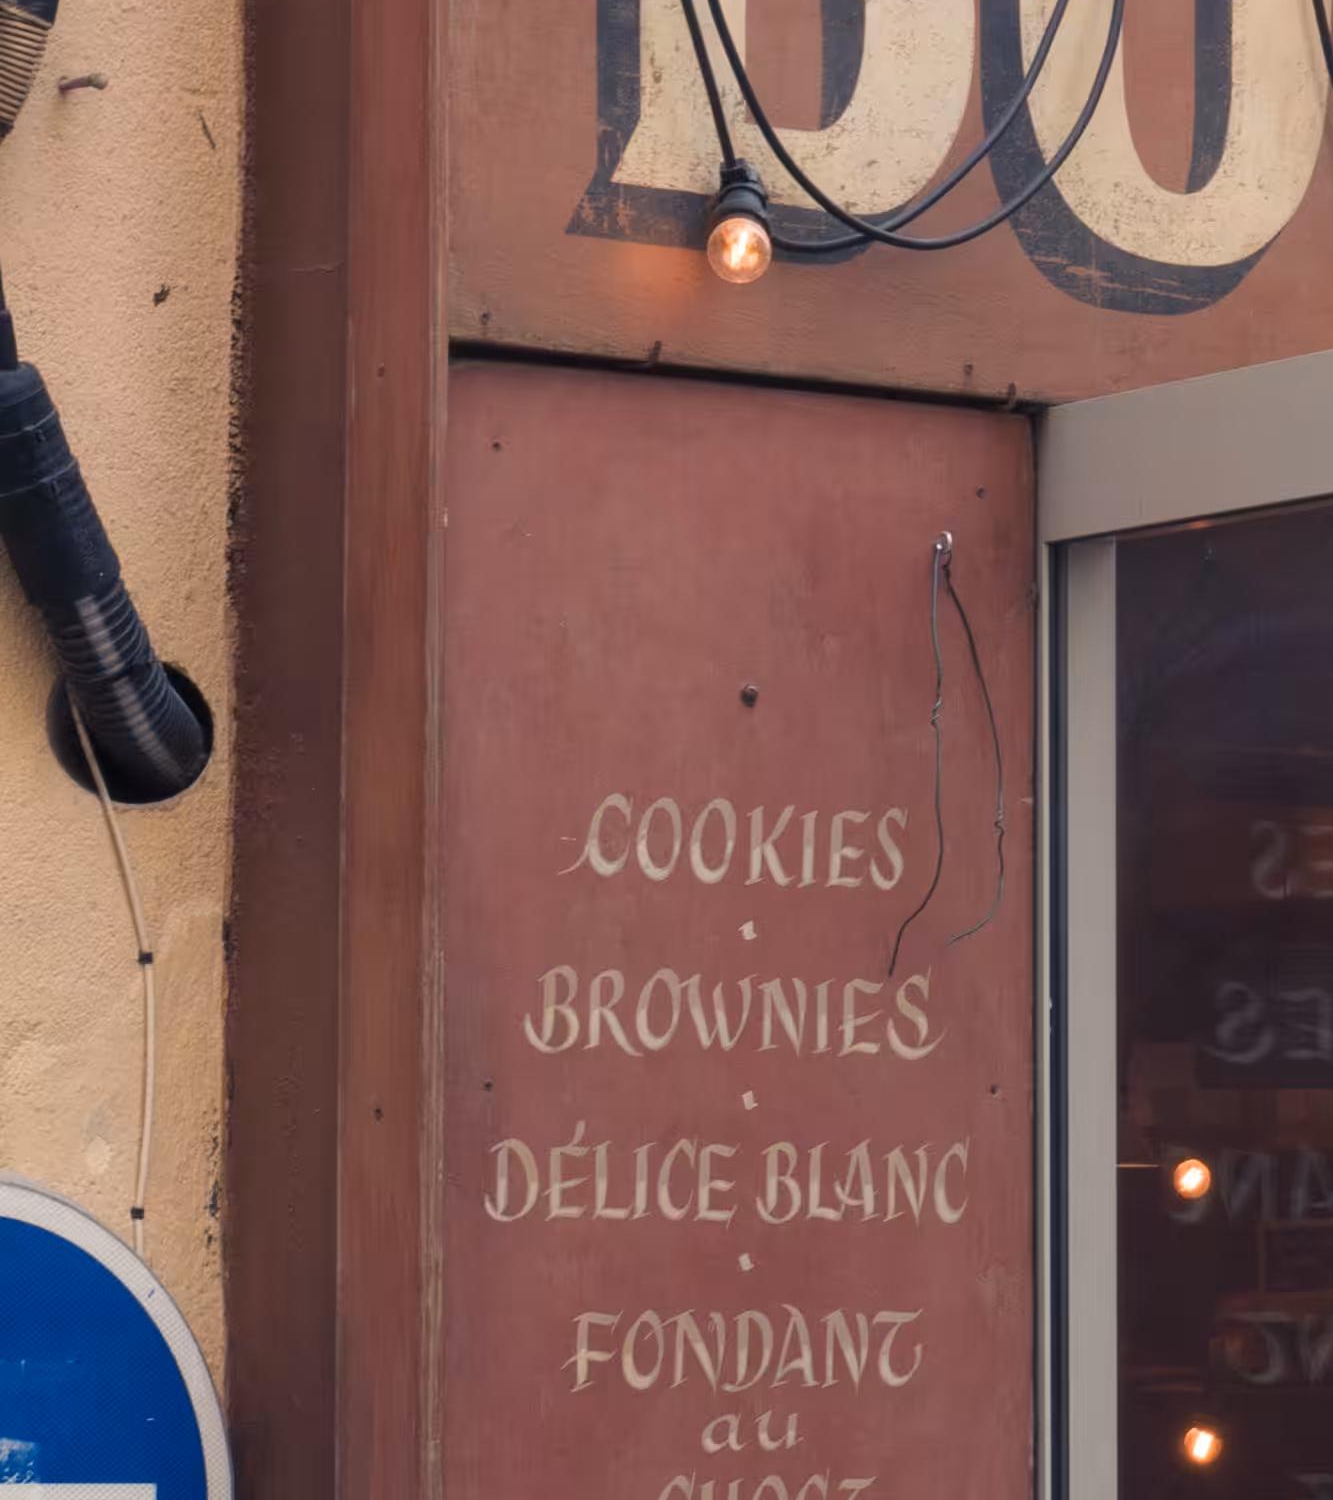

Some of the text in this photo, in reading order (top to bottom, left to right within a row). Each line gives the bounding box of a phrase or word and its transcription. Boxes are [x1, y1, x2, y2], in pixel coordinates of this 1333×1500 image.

[558, 793, 909, 891] COOKIES
[523, 963, 945, 1061] BROWNIES
[483, 1121, 971, 1228] DÉLICE BLANC
[559, 1303, 924, 1395] FONDANT
[700, 1408, 806, 1454] au
